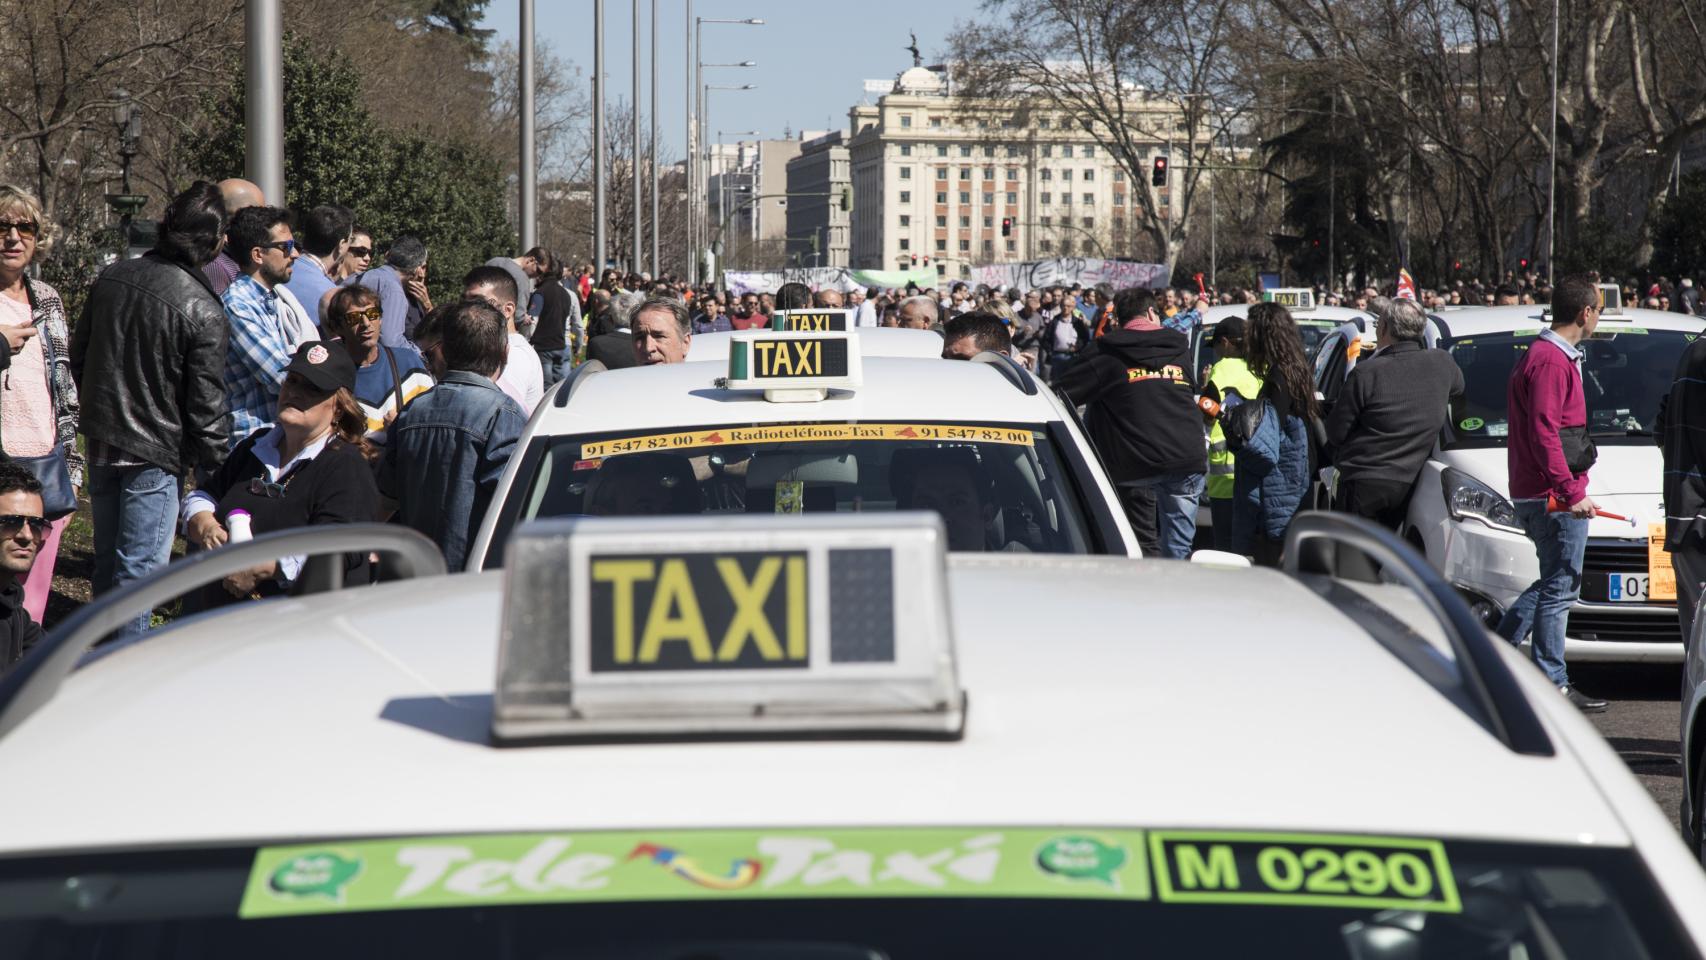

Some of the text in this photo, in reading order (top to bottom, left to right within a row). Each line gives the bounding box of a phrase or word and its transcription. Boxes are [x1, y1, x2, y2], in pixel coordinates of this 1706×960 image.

[1276, 294, 1298, 305] TAXI
[790, 315, 830, 331] TAXI
[755, 341, 822, 375] TAXI
[587, 426, 1027, 456] 91 547 82 00 Radioteléfono-Taxi 91 547 82 00
[592, 556, 807, 663] TAXI
[394, 837, 616, 899] Tele
[1175, 844, 1434, 898] M 0290
